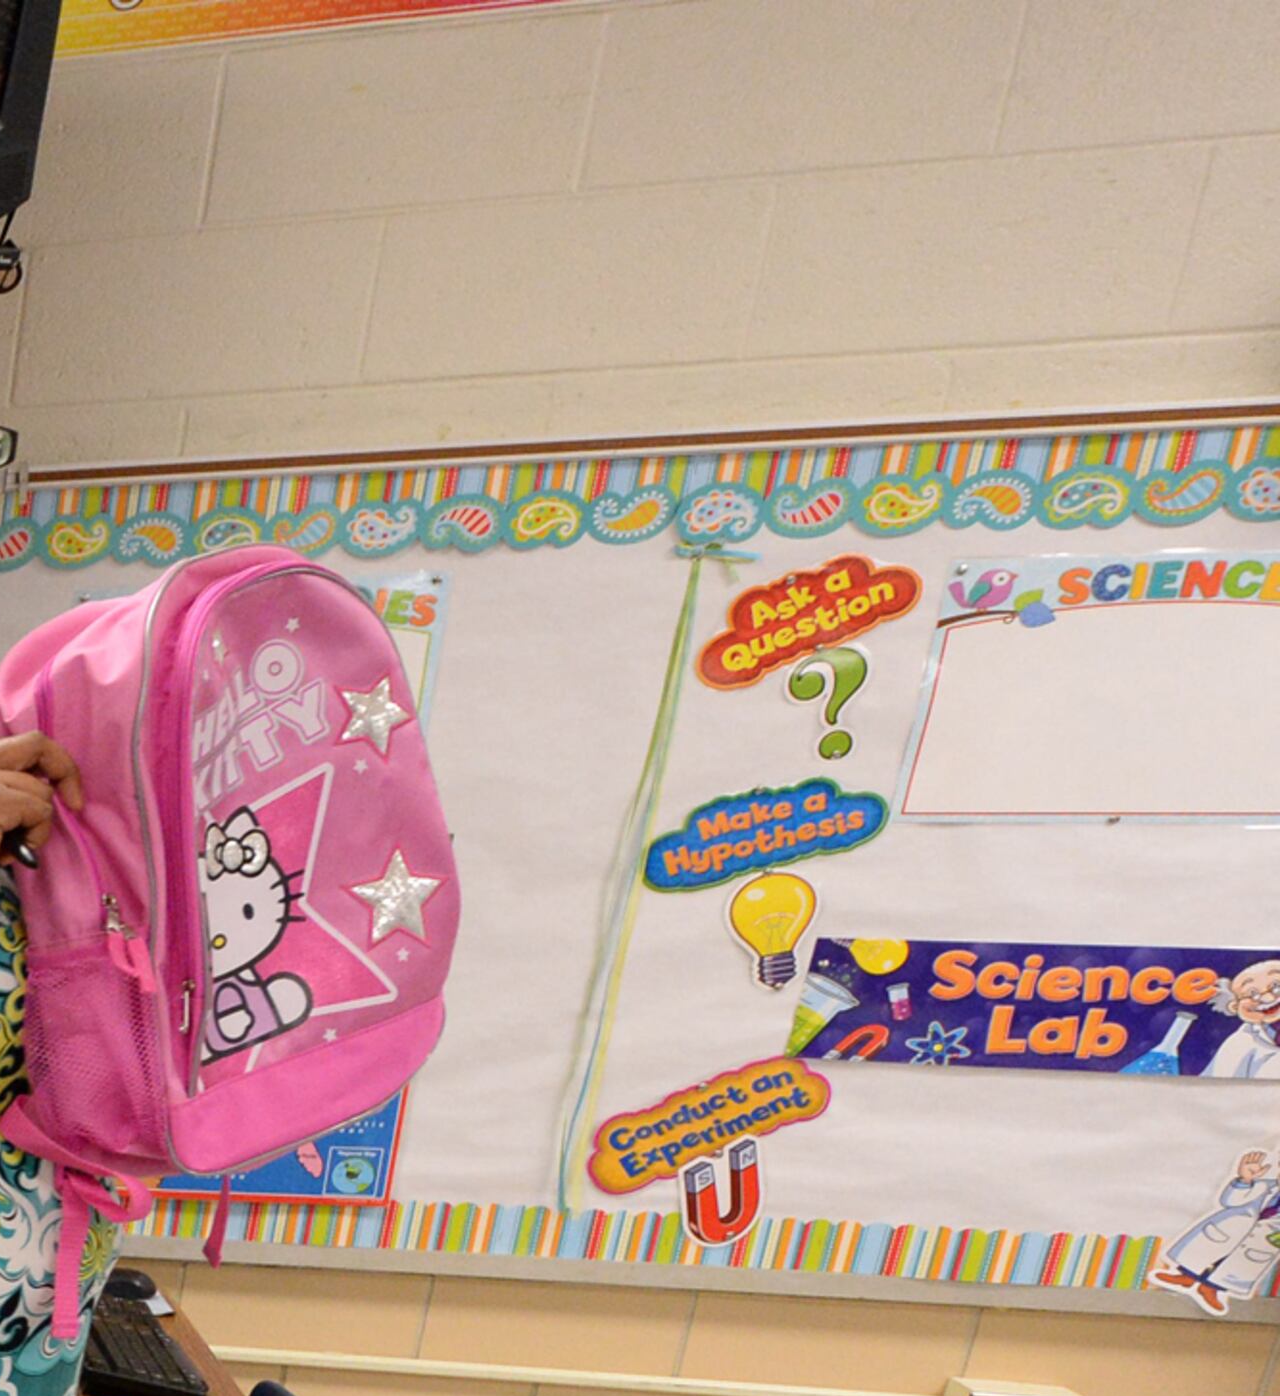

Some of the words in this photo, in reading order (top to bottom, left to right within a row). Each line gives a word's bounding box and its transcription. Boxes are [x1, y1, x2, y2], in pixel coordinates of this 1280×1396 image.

[721, 582, 895, 672] Question
[751, 585, 817, 630] Ask
[824, 569, 852, 594] a
[662, 809, 866, 878] Hypothesis
[696, 801, 793, 842] Make
[803, 792, 828, 813] a
[928, 949, 1220, 1005] Science
[985, 1004, 1129, 1059] Lab
[608, 1086, 749, 1151] Conduct
[752, 1071, 794, 1094] an
[618, 1087, 811, 1179] Experiment
